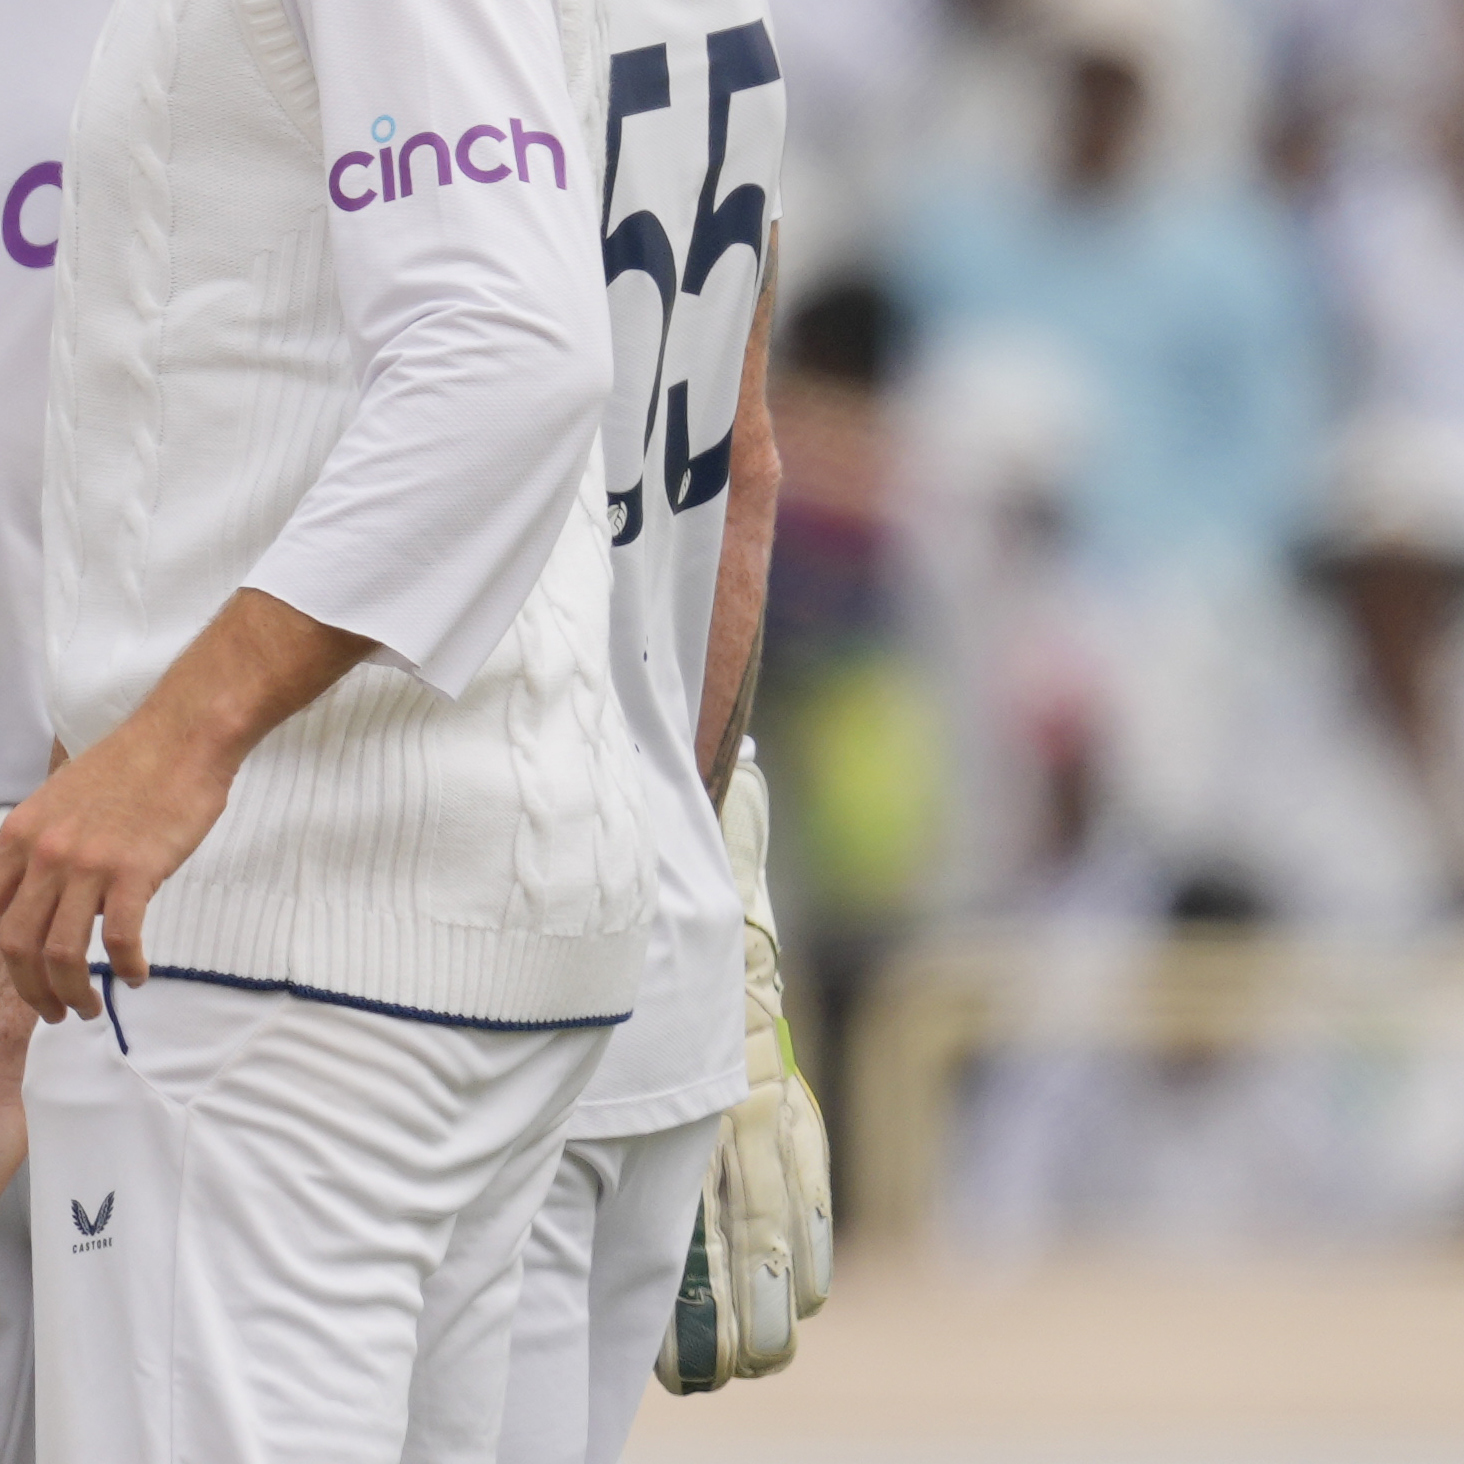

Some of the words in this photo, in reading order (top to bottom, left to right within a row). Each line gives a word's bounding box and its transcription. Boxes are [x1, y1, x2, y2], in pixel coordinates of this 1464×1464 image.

[329, 114, 568, 212] cinch
[603, 18, 782, 547] 55
[72, 1237, 113, 1254] CASTORE
